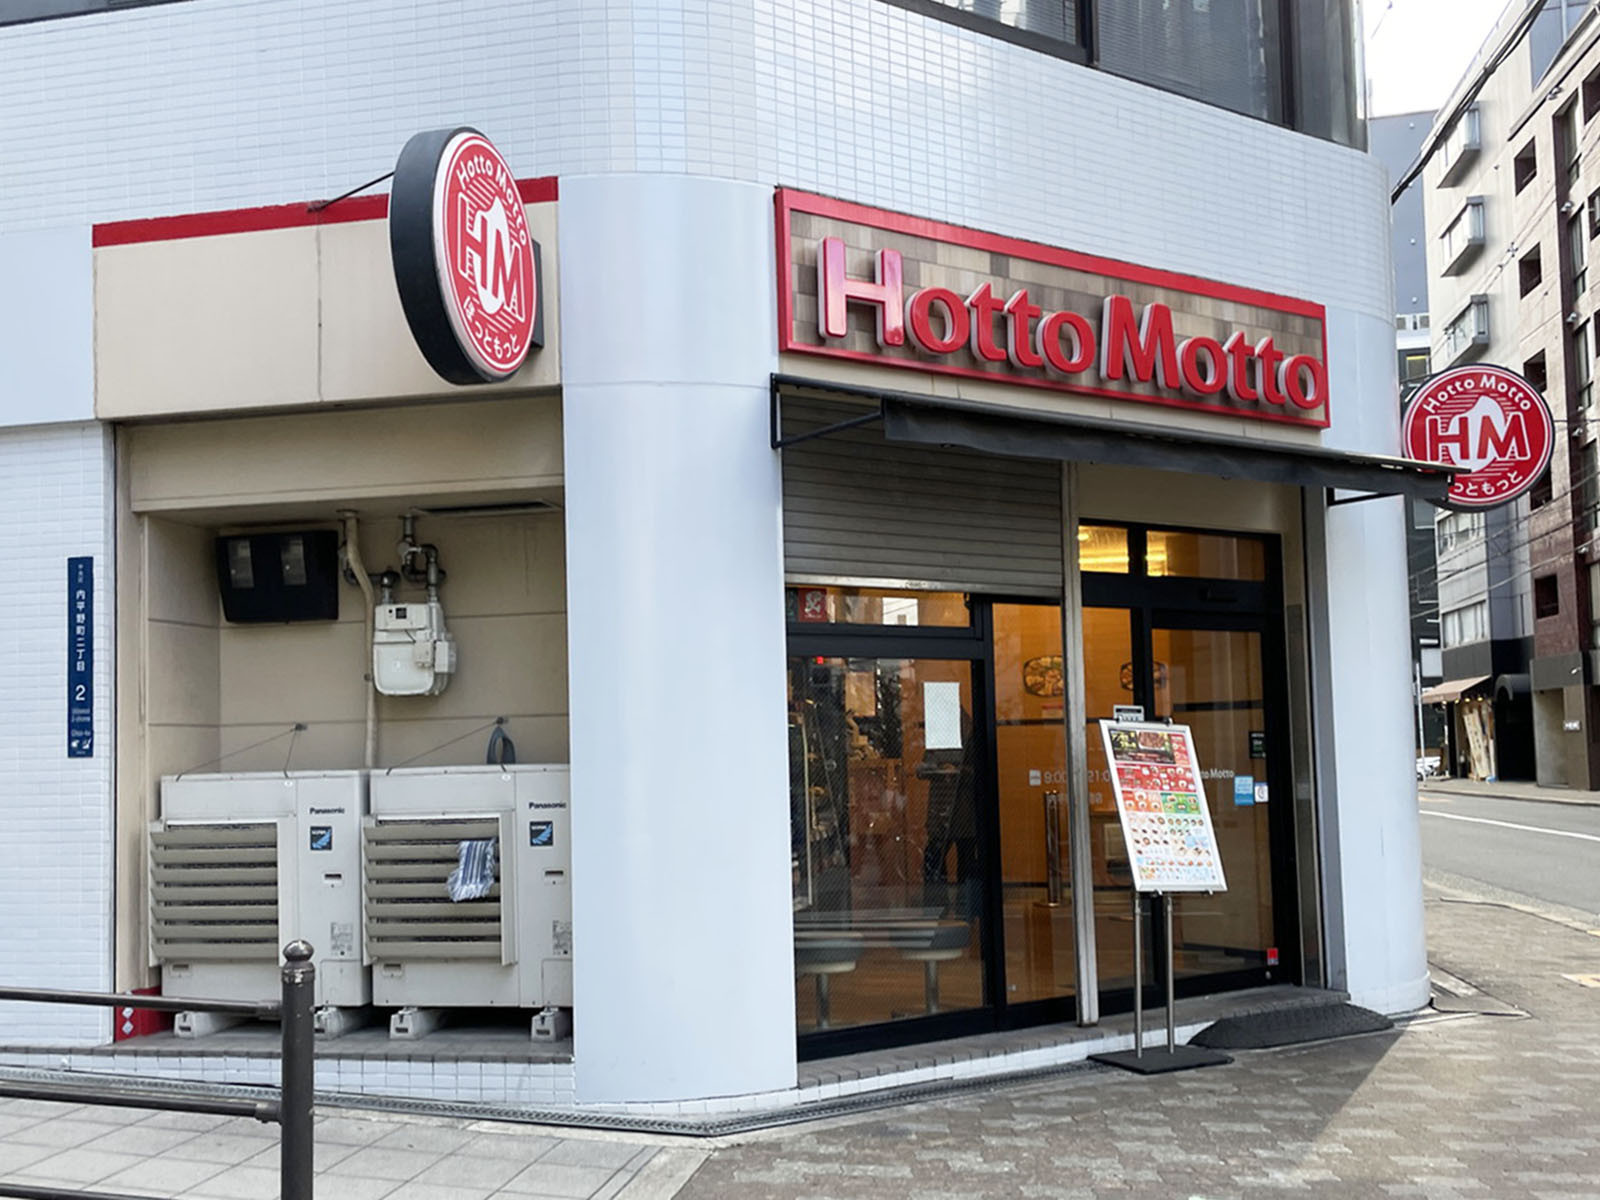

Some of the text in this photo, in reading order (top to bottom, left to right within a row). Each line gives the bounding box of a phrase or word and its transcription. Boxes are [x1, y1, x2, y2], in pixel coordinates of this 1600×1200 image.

[457, 154, 526, 246] Hotto Motto
[458, 191, 525, 323] HM
[463, 296, 520, 359] ほっともっと
[817, 236, 1324, 410] Hotto Motto
[1422, 375, 1531, 413] Hotto Motto
[1426, 411, 1531, 463] HM
[1454, 471, 1523, 496] っともっと
[76, 590, 86, 671] 内平野町二丁目
[75, 684, 86, 701] 2
